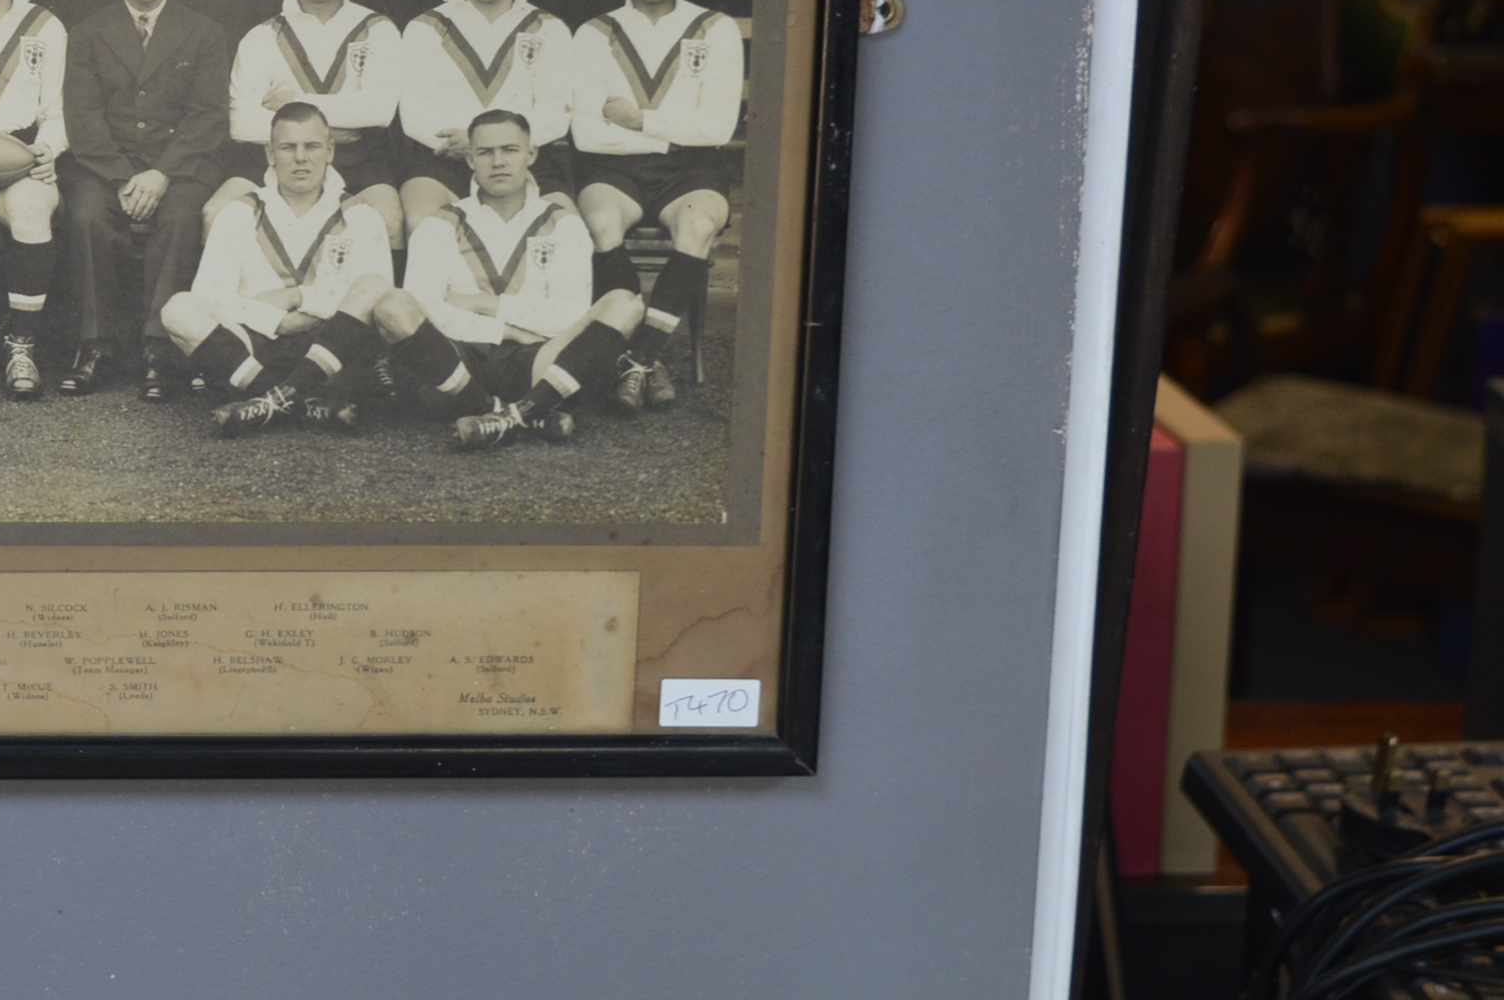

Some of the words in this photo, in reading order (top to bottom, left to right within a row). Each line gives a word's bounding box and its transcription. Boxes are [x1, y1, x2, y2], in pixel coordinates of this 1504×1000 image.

[41, 604, 88, 612] SILCOCK
[274, 603, 286, 611] H.
[291, 603, 368, 611] ELLERINGTON
[33, 614, 74, 622] (Widnes)
[158, 613, 197, 621] (Salford)
[309, 612, 337, 620] (Hull)
[156, 630, 189, 639] JONES
[385, 630, 431, 638] HUDSON
[20, 640, 63, 649] (Hunslet)
[254, 639, 301, 647] (Wakefield
[380, 638, 419, 647] (Salford)
[82, 657, 156, 665] POPPLEWELL
[230, 656, 283, 664] BELSHAW
[367, 656, 412, 664] MORLEY
[479, 656, 534, 664] EDWARDS
[72, 666, 101, 674] (Team
[106, 666, 148, 674] Manager)
[357, 665, 393, 674] (Wigan)
[476, 665, 515, 674] (Salford)
[18, 683, 52, 691] McCUE
[8, 692, 49, 701] (Widnes)
[119, 692, 153, 700] (Leeds)
[457, 693, 492, 703] Melba
[496, 692, 536, 703] Studios
[478, 708, 524, 716] SYDNEY,
[528, 707, 563, 716] N.S.W.
